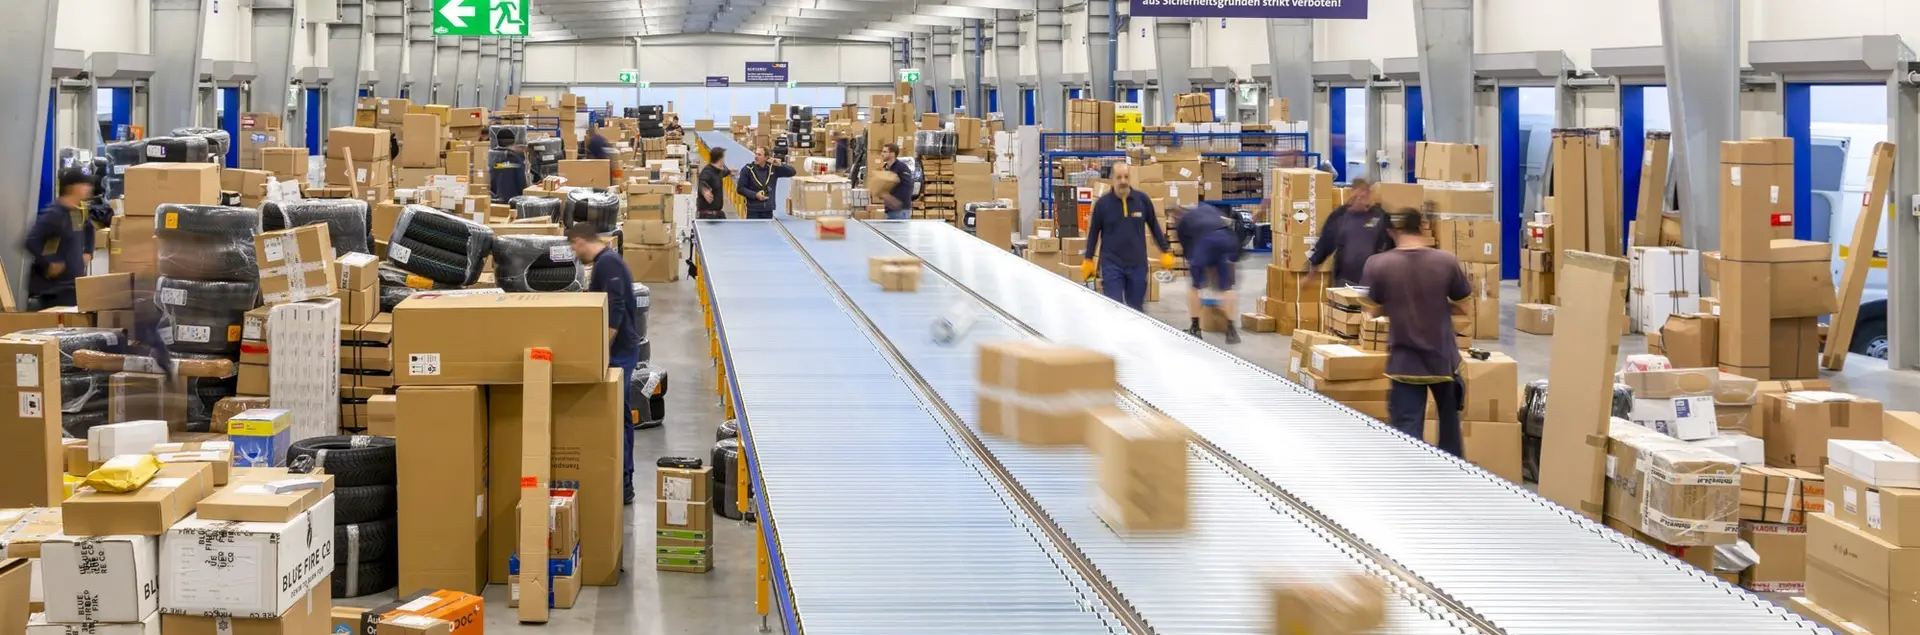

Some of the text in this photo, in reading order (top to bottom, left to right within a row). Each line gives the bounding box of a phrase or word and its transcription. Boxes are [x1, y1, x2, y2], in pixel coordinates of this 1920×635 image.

[282, 562, 303, 593] BLUE
[303, 547, 320, 575] FIRE
[321, 539, 331, 560] CO
